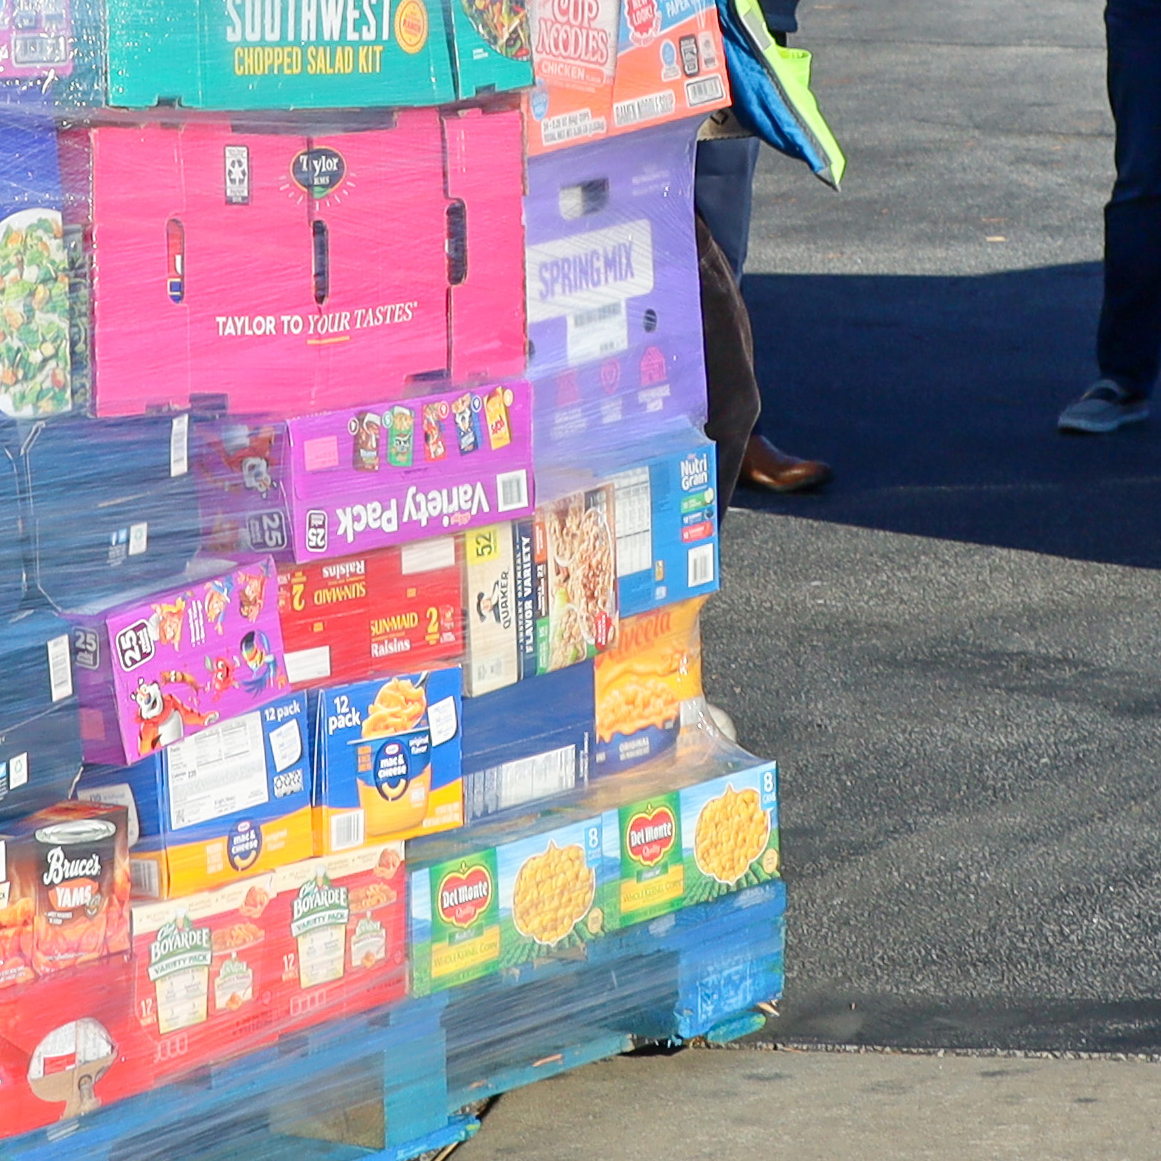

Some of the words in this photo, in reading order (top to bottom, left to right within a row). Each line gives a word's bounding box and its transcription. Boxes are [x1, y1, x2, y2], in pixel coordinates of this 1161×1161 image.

[632, 8, 654, 26] LOOK!
[537, 20, 608, 66] NOODLES
[235, 44, 303, 76] CHOPPED
[307, 46, 354, 75] SALAD
[358, 45, 384, 73] KIT
[541, 61, 586, 81] CHICKEN
[300, 155, 339, 176] Tylor
[538, 247, 601, 301] SPRING
[604, 240, 635, 283] MIX
[216, 315, 276, 336] TAYLOR
[281, 314, 303, 334] TO
[308, 309, 351, 335] YOUR
[680, 453, 708, 478] Nutri
[681, 471, 708, 491] Grain
[403, 482, 489, 527] Variety
[262, 513, 283, 547] 25
[336, 498, 398, 543] Pack
[308, 528, 325, 548] 25
[476, 530, 492, 558] 52
[322, 560, 365, 579] Raisins
[521, 536, 533, 598] VARIETY
[292, 584, 306, 611] 2
[500, 571, 513, 630] QUAKER
[426, 606, 440, 634] 2
[523, 599, 535, 654] FLAVOR
[75, 631, 97, 651] 25
[120, 629, 142, 667] 25
[371, 638, 411, 658] Raisins
[265, 706, 276, 722] 12
[276, 699, 301, 723] pack
[334, 695, 349, 714] 12
[328, 706, 361, 735] pack
[763, 771, 773, 792] 8
[589, 827, 598, 848] 8
[630, 828, 644, 847] Del
[645, 822, 672, 842] Monte
[43, 846, 101, 885] Bruce's
[56, 885, 93, 908] YAMS
[293, 886, 349, 921] BOYARDEE
[442, 889, 459, 909] Del
[459, 880, 488, 904] Monte
[296, 915, 327, 932] VARIETY
[327, 912, 346, 922] PACK
[151, 927, 211, 963] BOYARDEE
[154, 959, 188, 975] VARIETY
[188, 953, 208, 966] PACK
[282, 953, 295, 969] 12
[140, 998, 153, 1018] 12
